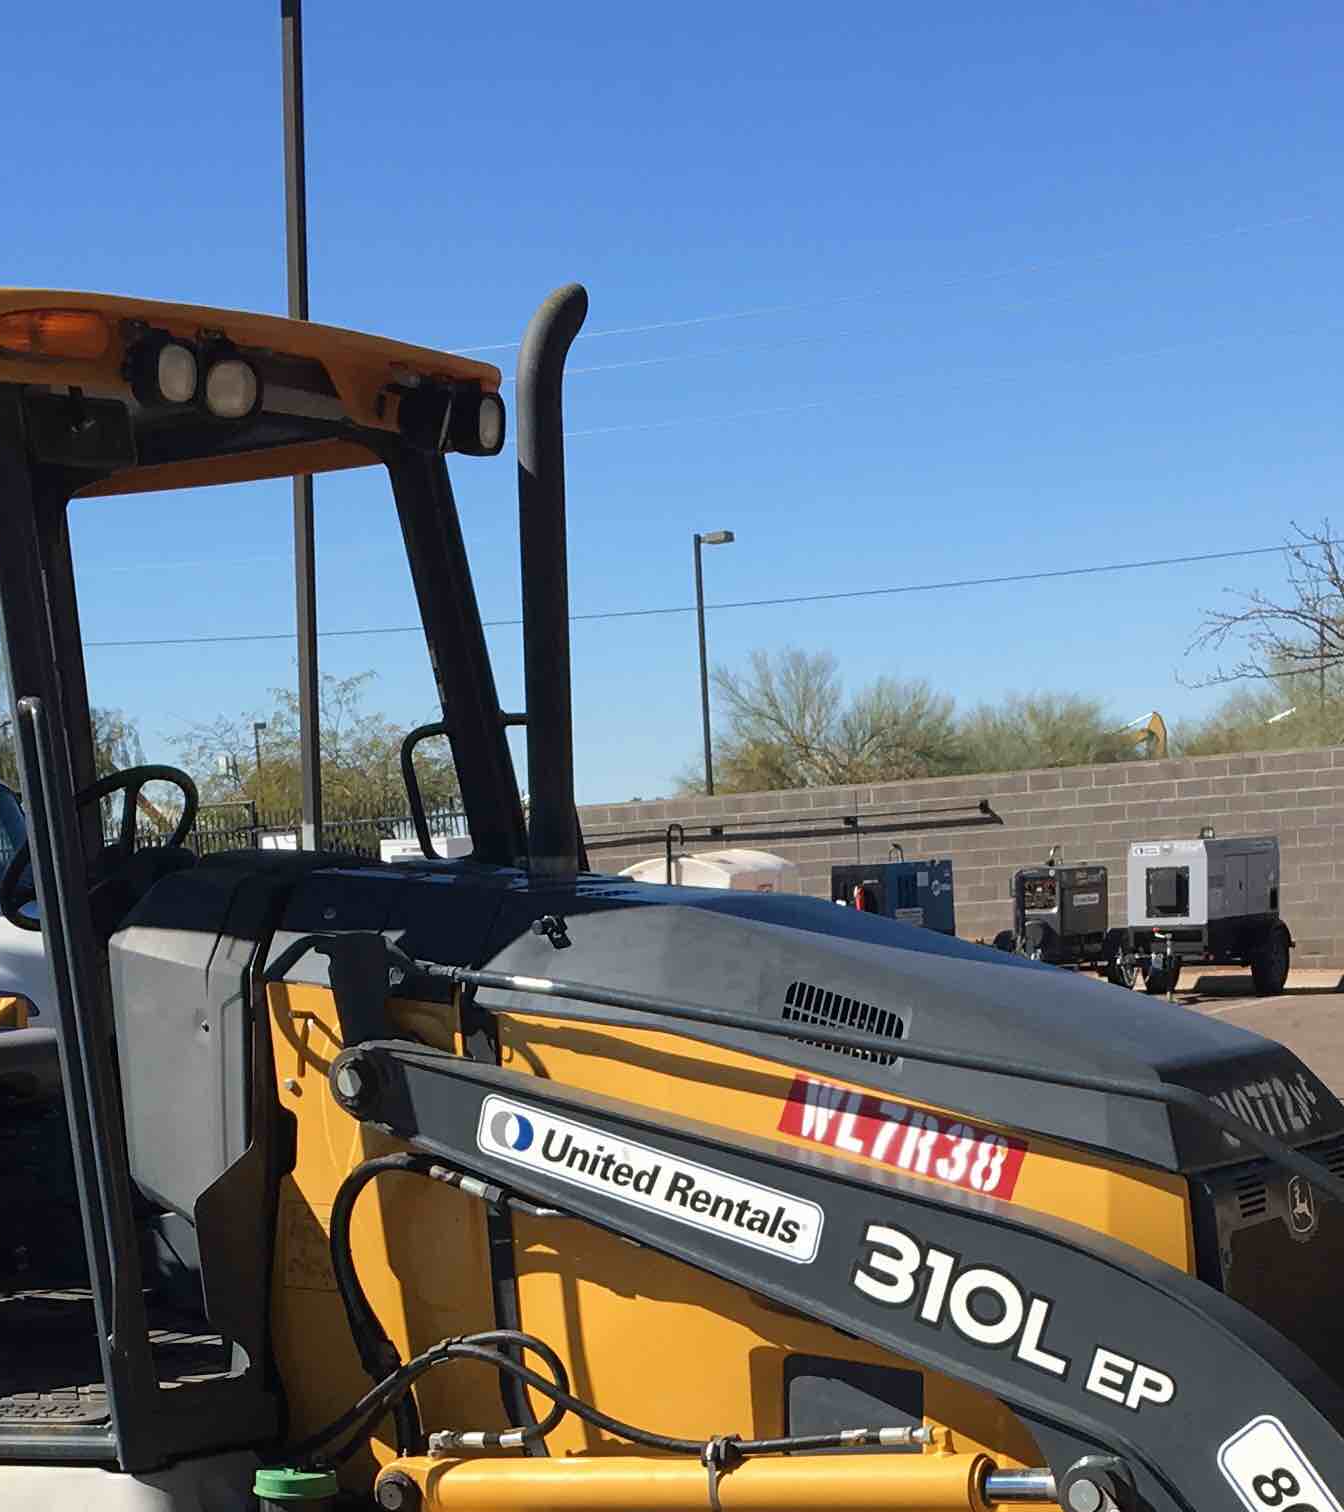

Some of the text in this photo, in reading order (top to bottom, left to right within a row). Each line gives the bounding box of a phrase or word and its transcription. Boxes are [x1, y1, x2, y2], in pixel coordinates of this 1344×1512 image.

[541, 1129, 801, 1246] United Rentals
[800, 1078, 1009, 1191] WL7R38
[854, 1225, 1175, 1410] 310L EP
